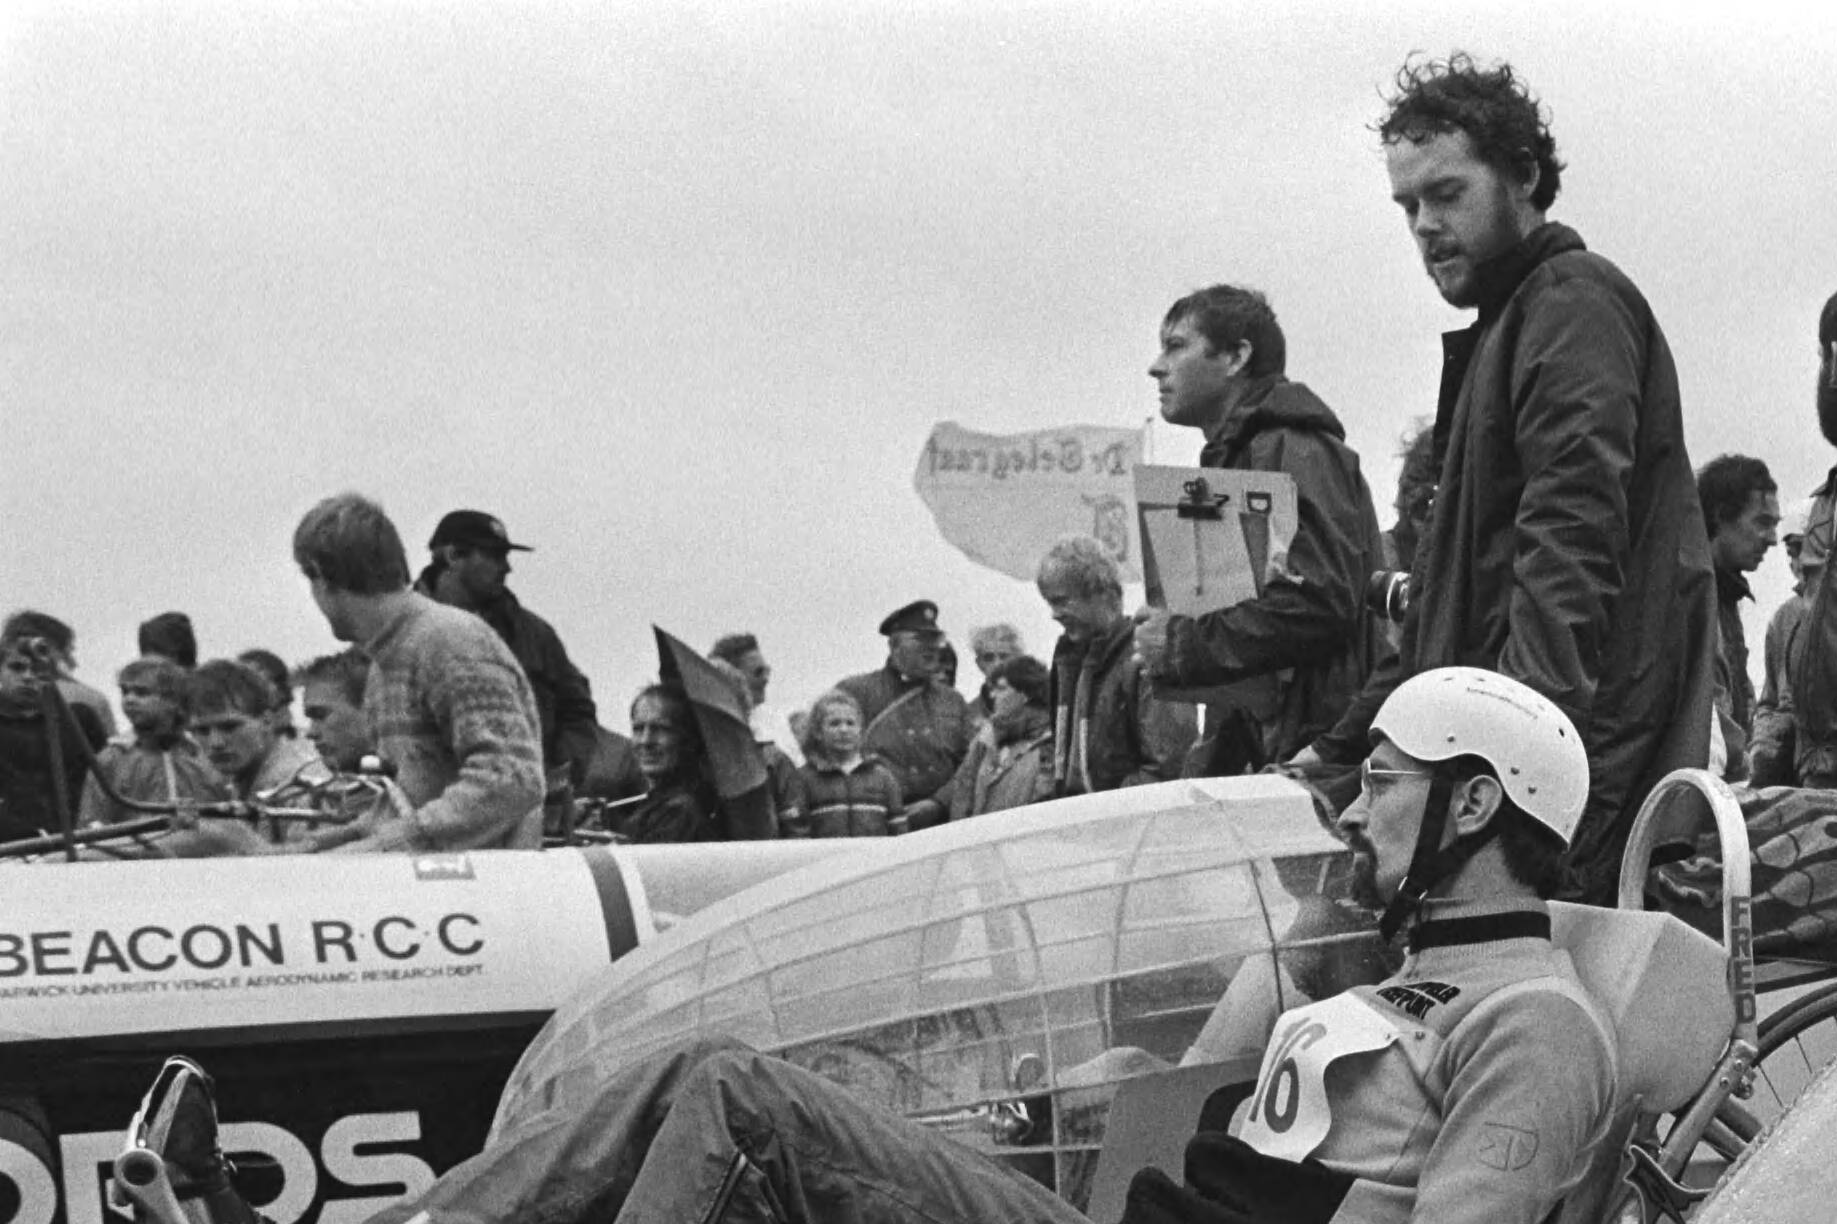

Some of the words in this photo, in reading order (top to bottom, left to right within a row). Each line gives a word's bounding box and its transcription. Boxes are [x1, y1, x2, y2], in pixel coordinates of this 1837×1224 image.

[0, 923, 285, 978] BEACON
[1731, 896, 1756, 1024] FRED
[0, 983, 67, 998] ARWICK
